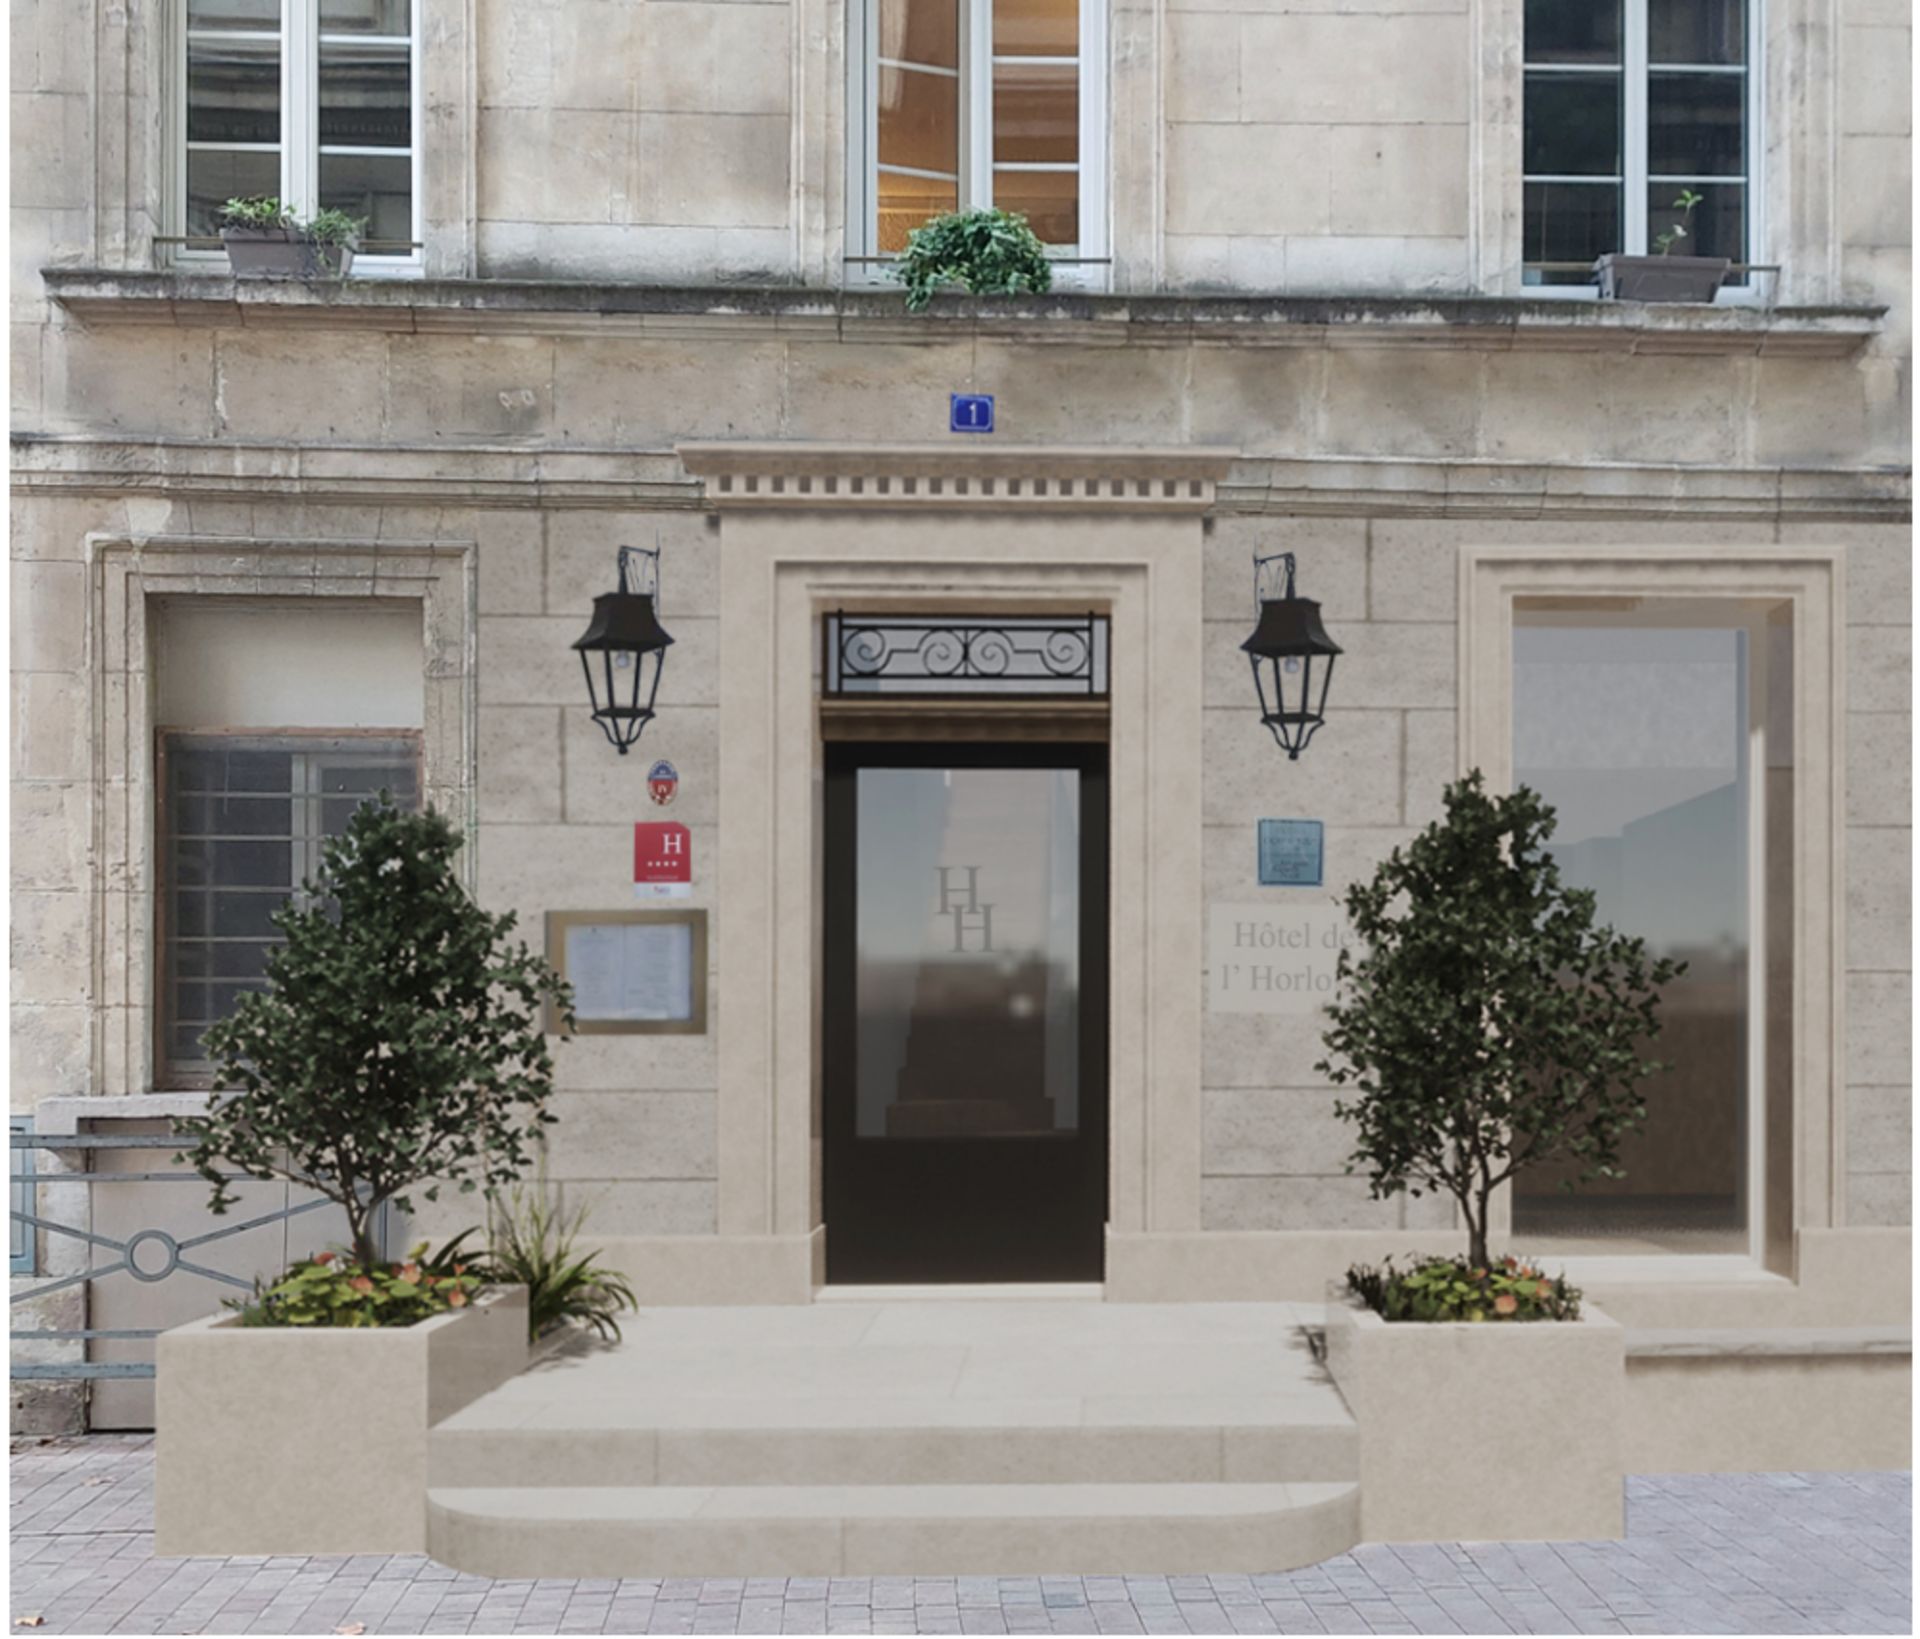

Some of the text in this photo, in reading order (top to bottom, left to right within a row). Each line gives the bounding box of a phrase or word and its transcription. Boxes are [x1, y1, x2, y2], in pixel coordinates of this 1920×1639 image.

[969, 403, 976, 424] 1
[663, 833, 682, 855] H
[1234, 922, 1355, 948] Hôtel de
[1249, 965, 1332, 991] Horlo
